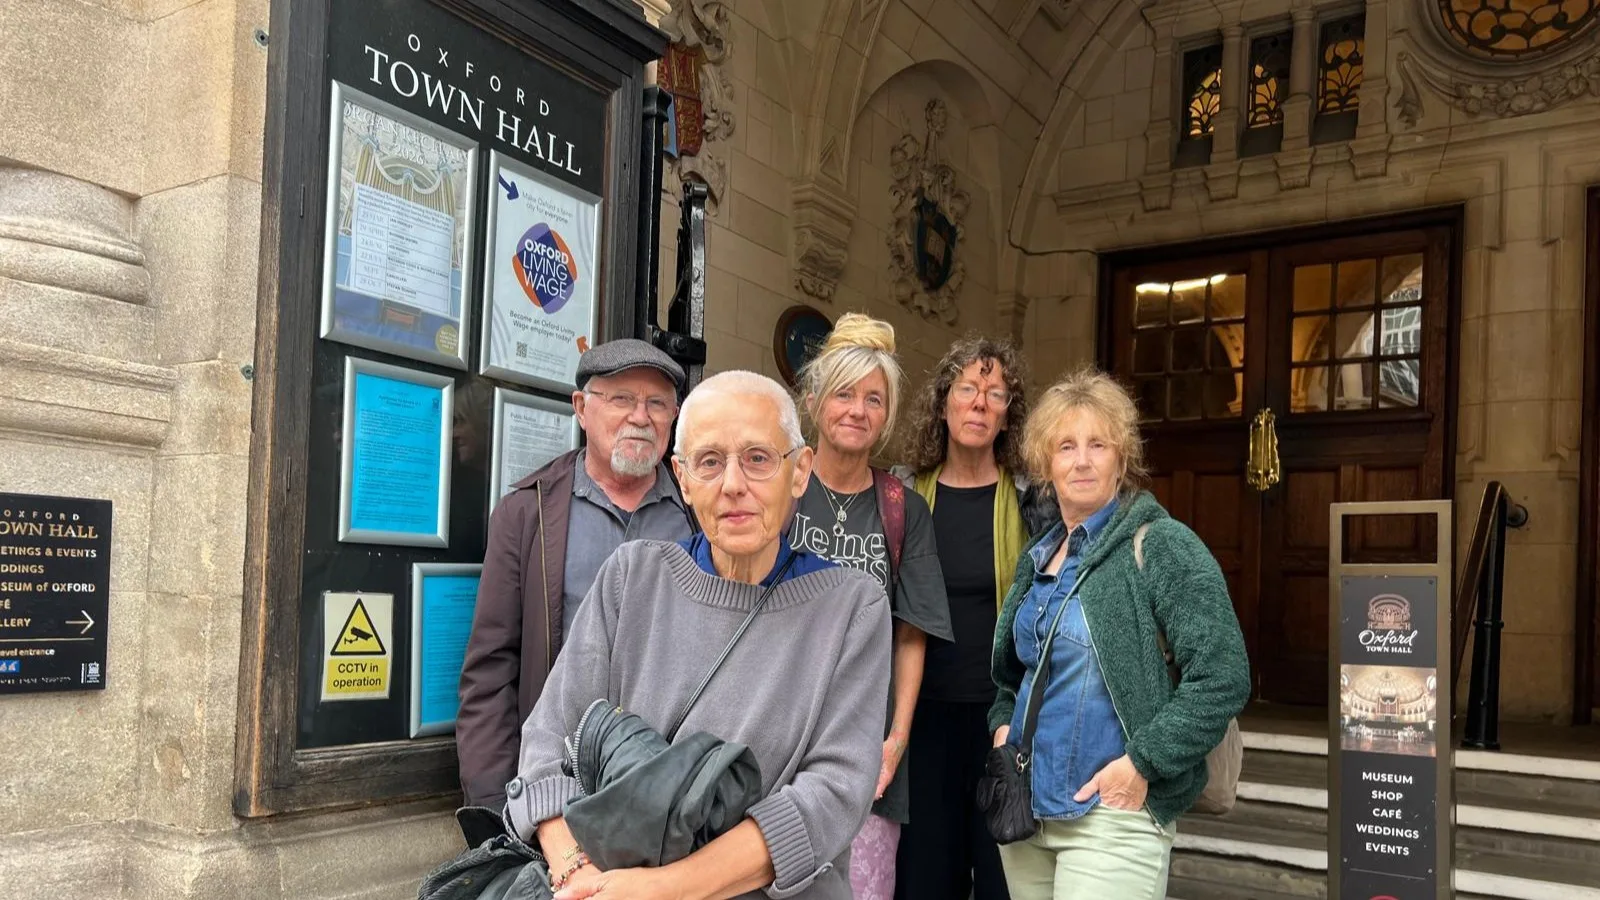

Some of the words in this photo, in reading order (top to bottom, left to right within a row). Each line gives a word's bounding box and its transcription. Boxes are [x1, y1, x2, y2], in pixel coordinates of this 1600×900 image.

[407, 34, 549, 115] OXFORD
[365, 45, 484, 131] TOWN
[496, 107, 581, 175] HALL
[537, 197, 555, 210] Oxford
[524, 238, 569, 265] OXFORD
[523, 253, 567, 279] LIVING
[523, 268, 567, 299] WAGE
[509, 310, 532, 323] Become
[541, 319, 559, 331] Oxford
[560, 327, 575, 337] Living
[512, 320, 529, 330] Wage
[530, 326, 554, 338] employer
[4, 509, 79, 521] OXFORD
[0, 520, 43, 536] OWN
[48, 523, 98, 539] HALL
[790, 513, 829, 554] Je
[831, 533, 886, 559] ne
[1, 546, 41, 556] ETINGS
[45, 547, 53, 556] &
[56, 547, 97, 558] EVENTS
[1, 563, 44, 574] DDINGS
[1, 581, 32, 592] SEUM
[36, 582, 48, 592] of
[52, 582, 95, 592] OXFORD
[1358, 629, 1418, 647] Oxford
[18, 648, 56, 656] entrance
[338, 663, 367, 674] CCTV
[369, 663, 379, 673] in
[332, 677, 381, 688] operation
[1362, 771, 1413, 784] MUSEUM
[1371, 790, 1403, 801] SHOP
[1372, 808, 1402, 819] CAFÉ
[1356, 823, 1419, 839] WEDDINGS
[1365, 842, 1409, 855] EVENTS
